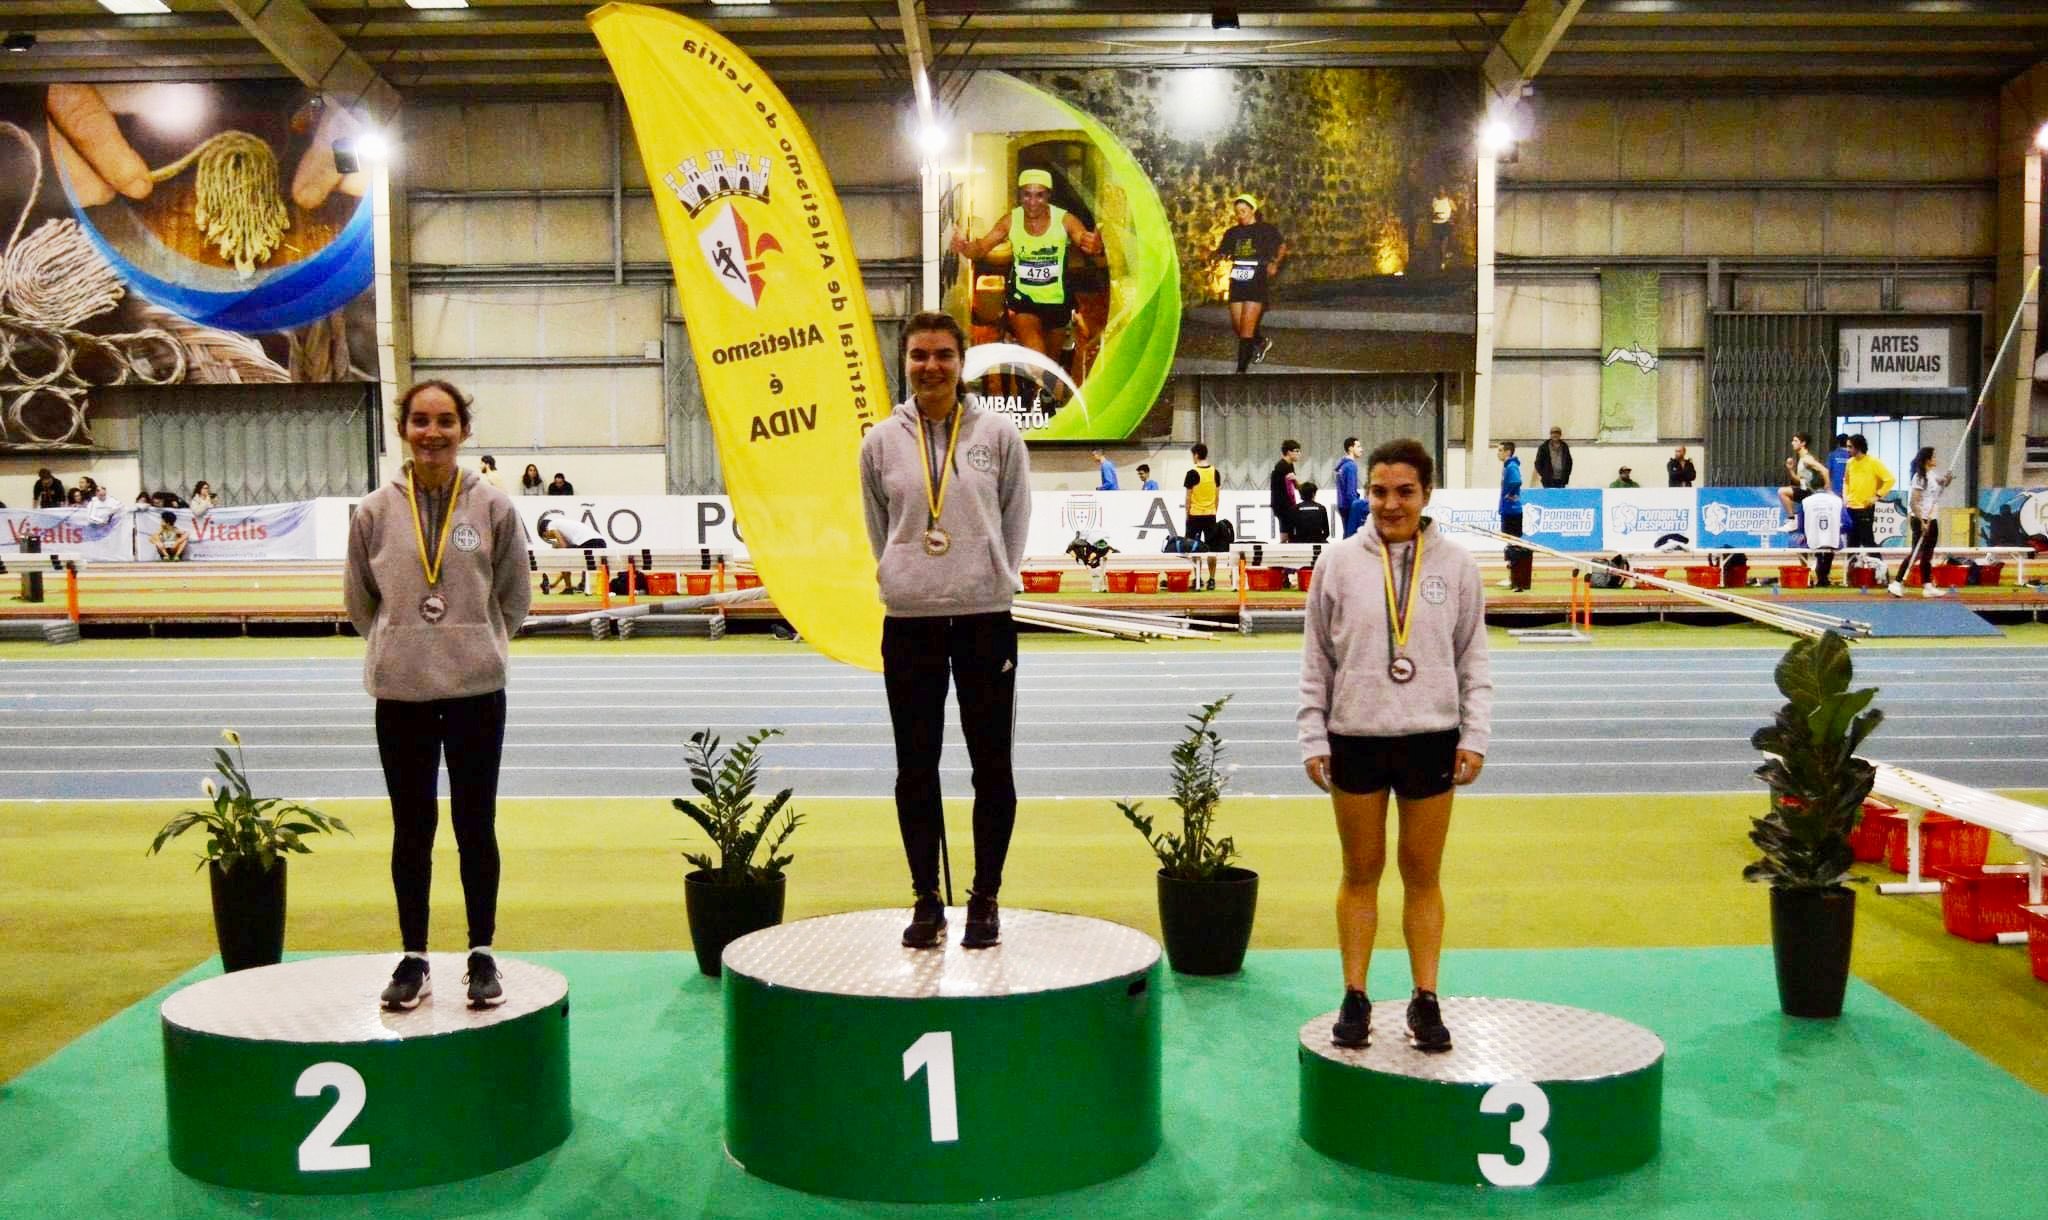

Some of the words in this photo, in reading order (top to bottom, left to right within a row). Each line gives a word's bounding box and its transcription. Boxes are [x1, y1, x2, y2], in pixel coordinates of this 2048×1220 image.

[1027, 267, 1050, 279] 478
[1871, 335, 1919, 353] ARTES
[1871, 355, 1941, 373] MANUAIS
[1543, 510, 1583, 520] POMBAL
[1638, 510, 1679, 521] POMBAL
[1730, 510, 1769, 519] POMBAL
[8, 516, 84, 545] Vitalis
[192, 514, 268, 541] Vitalis
[1542, 520, 1592, 530] DESPORTO
[1637, 520, 1687, 531] DESPORTO
[903, 1032, 958, 1142] 1
[296, 1063, 371, 1172] 2
[1478, 1081, 1550, 1187] 3
